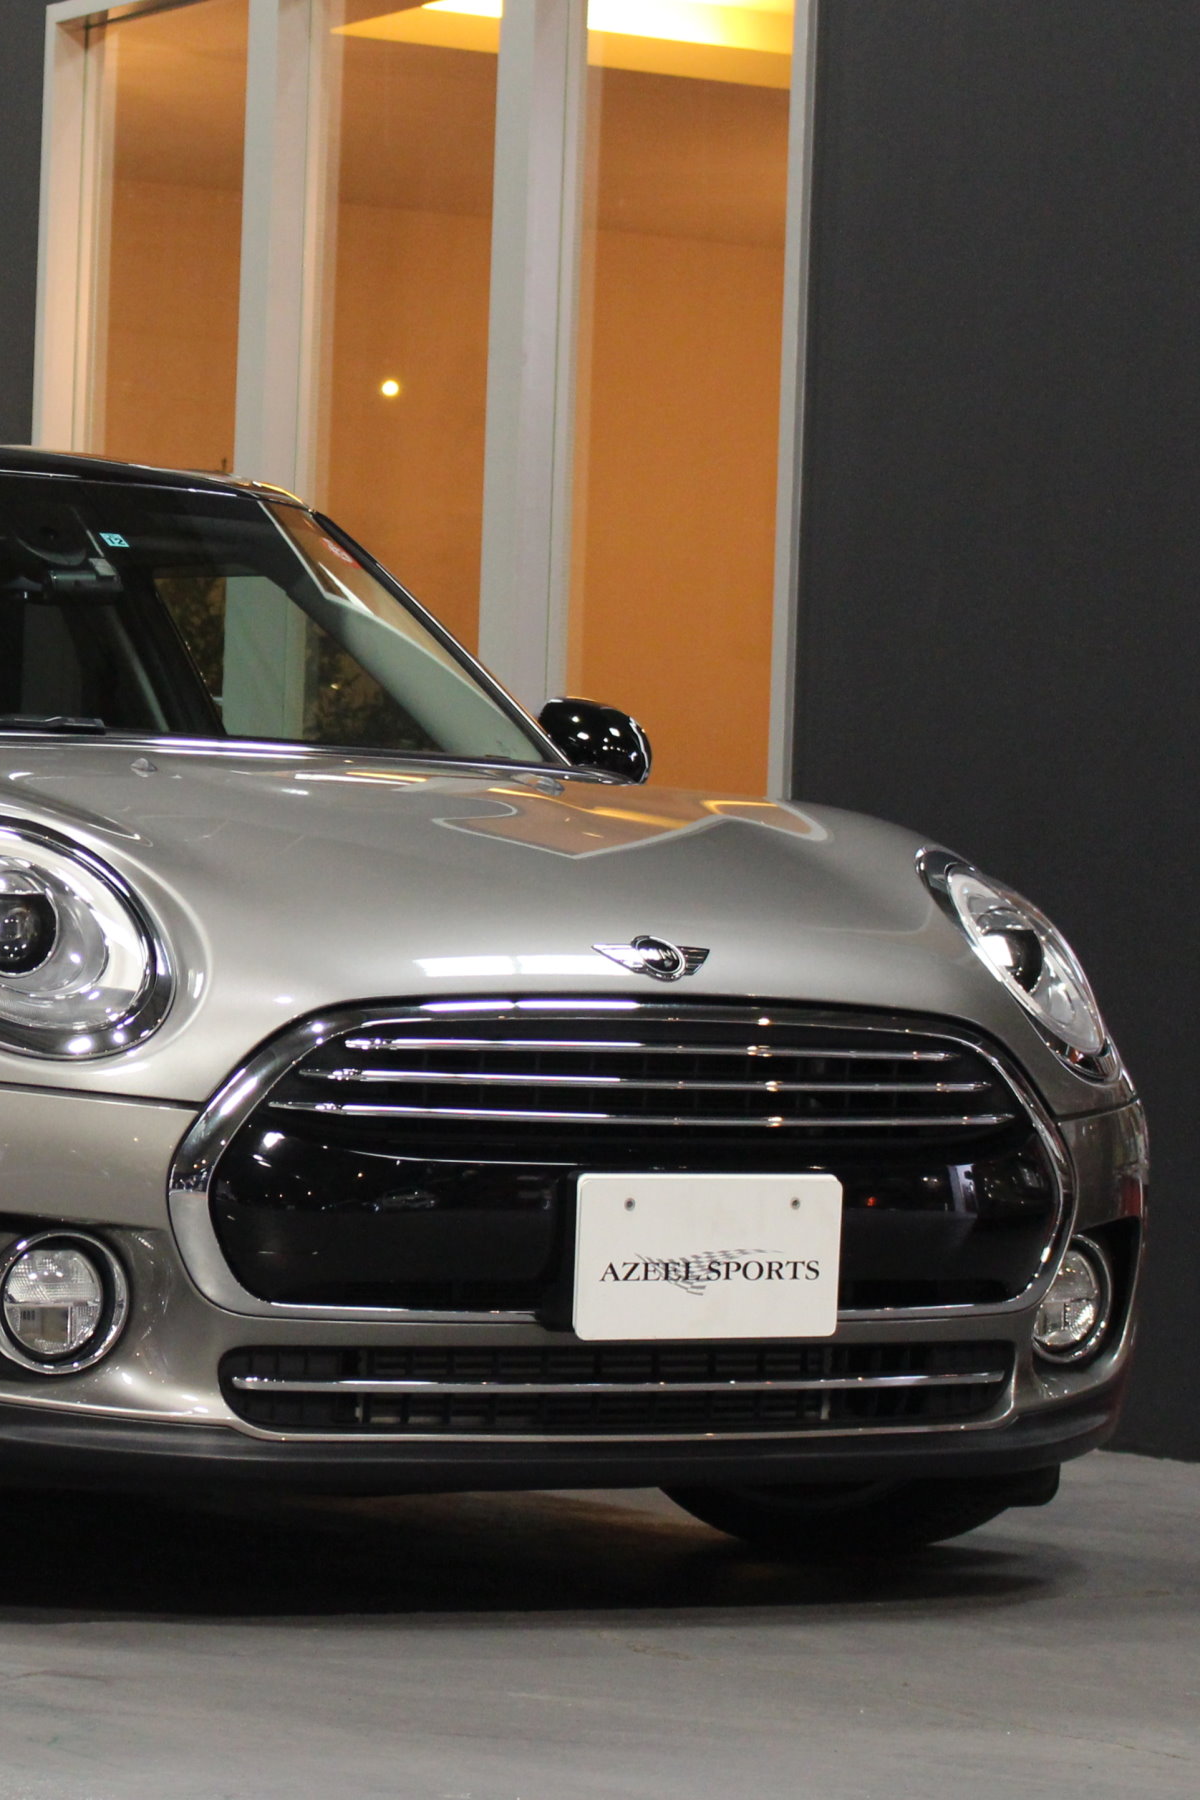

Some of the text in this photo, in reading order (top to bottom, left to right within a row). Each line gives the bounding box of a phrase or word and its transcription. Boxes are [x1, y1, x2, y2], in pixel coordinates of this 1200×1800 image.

[107, 536, 126, 546] 12
[600, 1260, 820, 1282] AZEEL SPORTS
